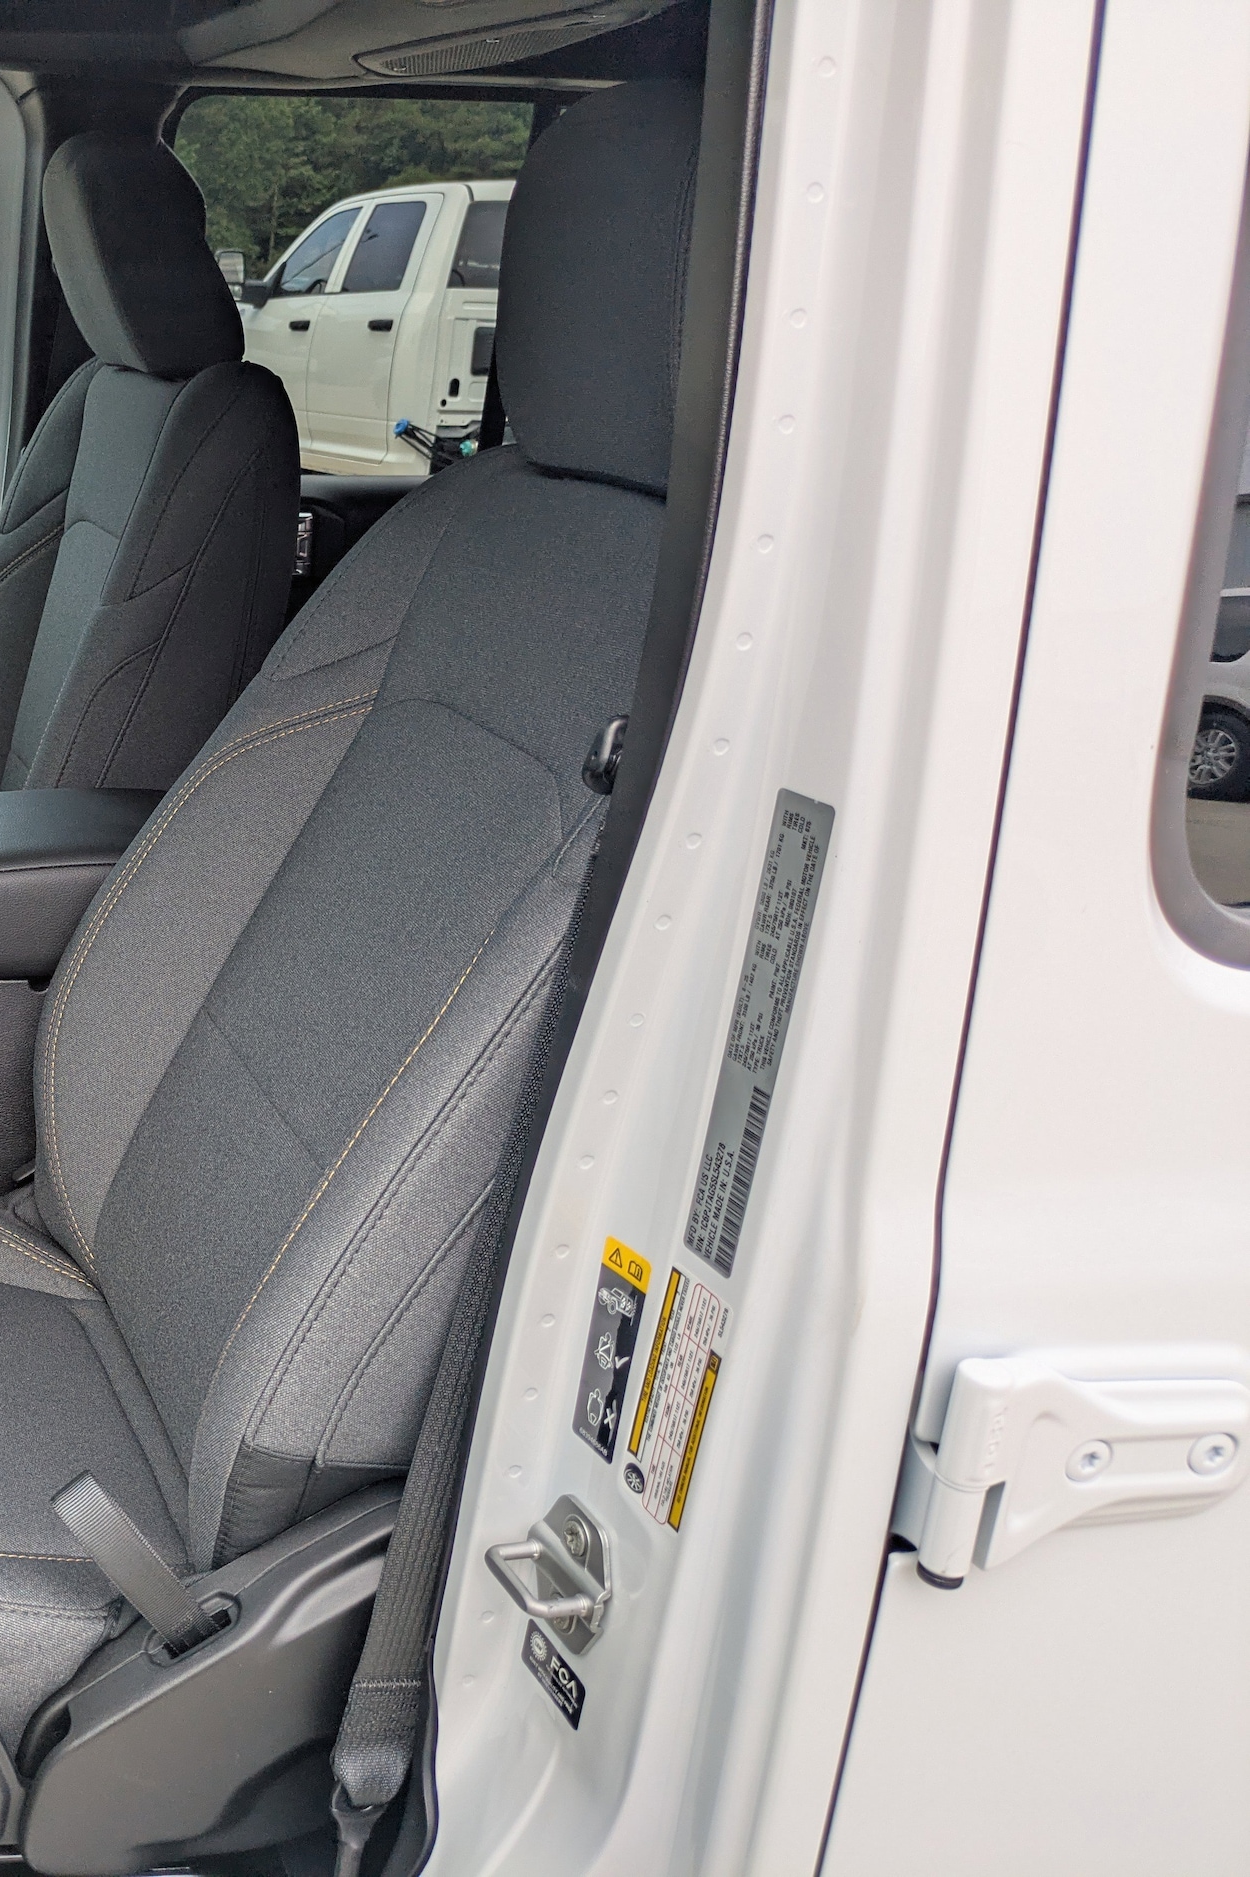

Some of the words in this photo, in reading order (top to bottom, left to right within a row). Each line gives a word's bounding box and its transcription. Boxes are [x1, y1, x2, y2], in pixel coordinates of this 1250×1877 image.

[781, 809, 790, 827] WITH
[778, 832, 785, 842] KG
[813, 843, 820, 852] OF
[804, 835, 816, 862] VEHICLE
[771, 865, 778, 874] LB
[809, 853, 817, 871] DATE
[799, 862, 809, 885] MOTOR
[758, 942, 766, 959] RIMS
[764, 913, 772, 934] 17X7.5
[786, 812, 794, 829] RIMS
[763, 942, 772, 961] TIRES
[791, 812, 800, 830] TIRES
[803, 887, 810, 897] ON
[763, 892, 772, 913] REAR:
[793, 886, 804, 915] FEDERAL
[798, 897, 808, 921] EFFECT
[758, 913, 768, 933] GAWR
[788, 916, 798, 935] U.S.A.
[796, 921, 802, 929] IN
[726, 1042, 734, 1059] DATE
[730, 1033, 736, 1042] OF
[753, 909, 762, 930] GVWR:
[762, 882, 768, 890] LB
[768, 849, 775, 859] KG
[746, 1061, 752, 1071] AT
[768, 947, 777, 965] COLD
[774, 931, 781, 941] AT
[784, 878, 792, 890] PSI
[797, 816, 806, 834] COLD
[754, 939, 762, 956] WITH
[788, 930, 800, 967] STANDARDS
[780, 936, 793, 974] APPLICABLE
[777, 973, 785, 986] ALL
[779, 968, 792, 1007] PREVENTION
[784, 967, 798, 1014] MANUFACTURE
[794, 943, 804, 967] SHOWN
[744, 993, 750, 1002] LB
[775, 986, 782, 996] TO
[756, 1034, 764, 1055] TRUCK
[768, 978, 777, 999] PAINT:
[768, 996, 780, 1030] CONFORMS
[775, 1007, 784, 1027] THEFT
[735, 1019, 745, 1042] FRONT:
[771, 1028, 779, 1043] AND
[731, 1042, 740, 1062] GAWR
[762, 1030, 773, 1055] VEHICLE
[759, 1055, 767, 1070] THIS
[766, 1042, 776, 1066] SAFETY
[702, 1152, 712, 1172] LLC
[721, 1147, 734, 1178] U.S.A.
[699, 1171, 708, 1187] US
[717, 1176, 728, 1194] IN:
[695, 1186, 705, 1206] FCA
[691, 1206, 701, 1225] BY:
[711, 1192, 724, 1222] MADE
[686, 1224, 697, 1248] MFD
[695, 1232, 706, 1254] VIN:
[703, 1220, 718, 1261] VEHICLE
[549, 1656, 578, 1699] FCA
